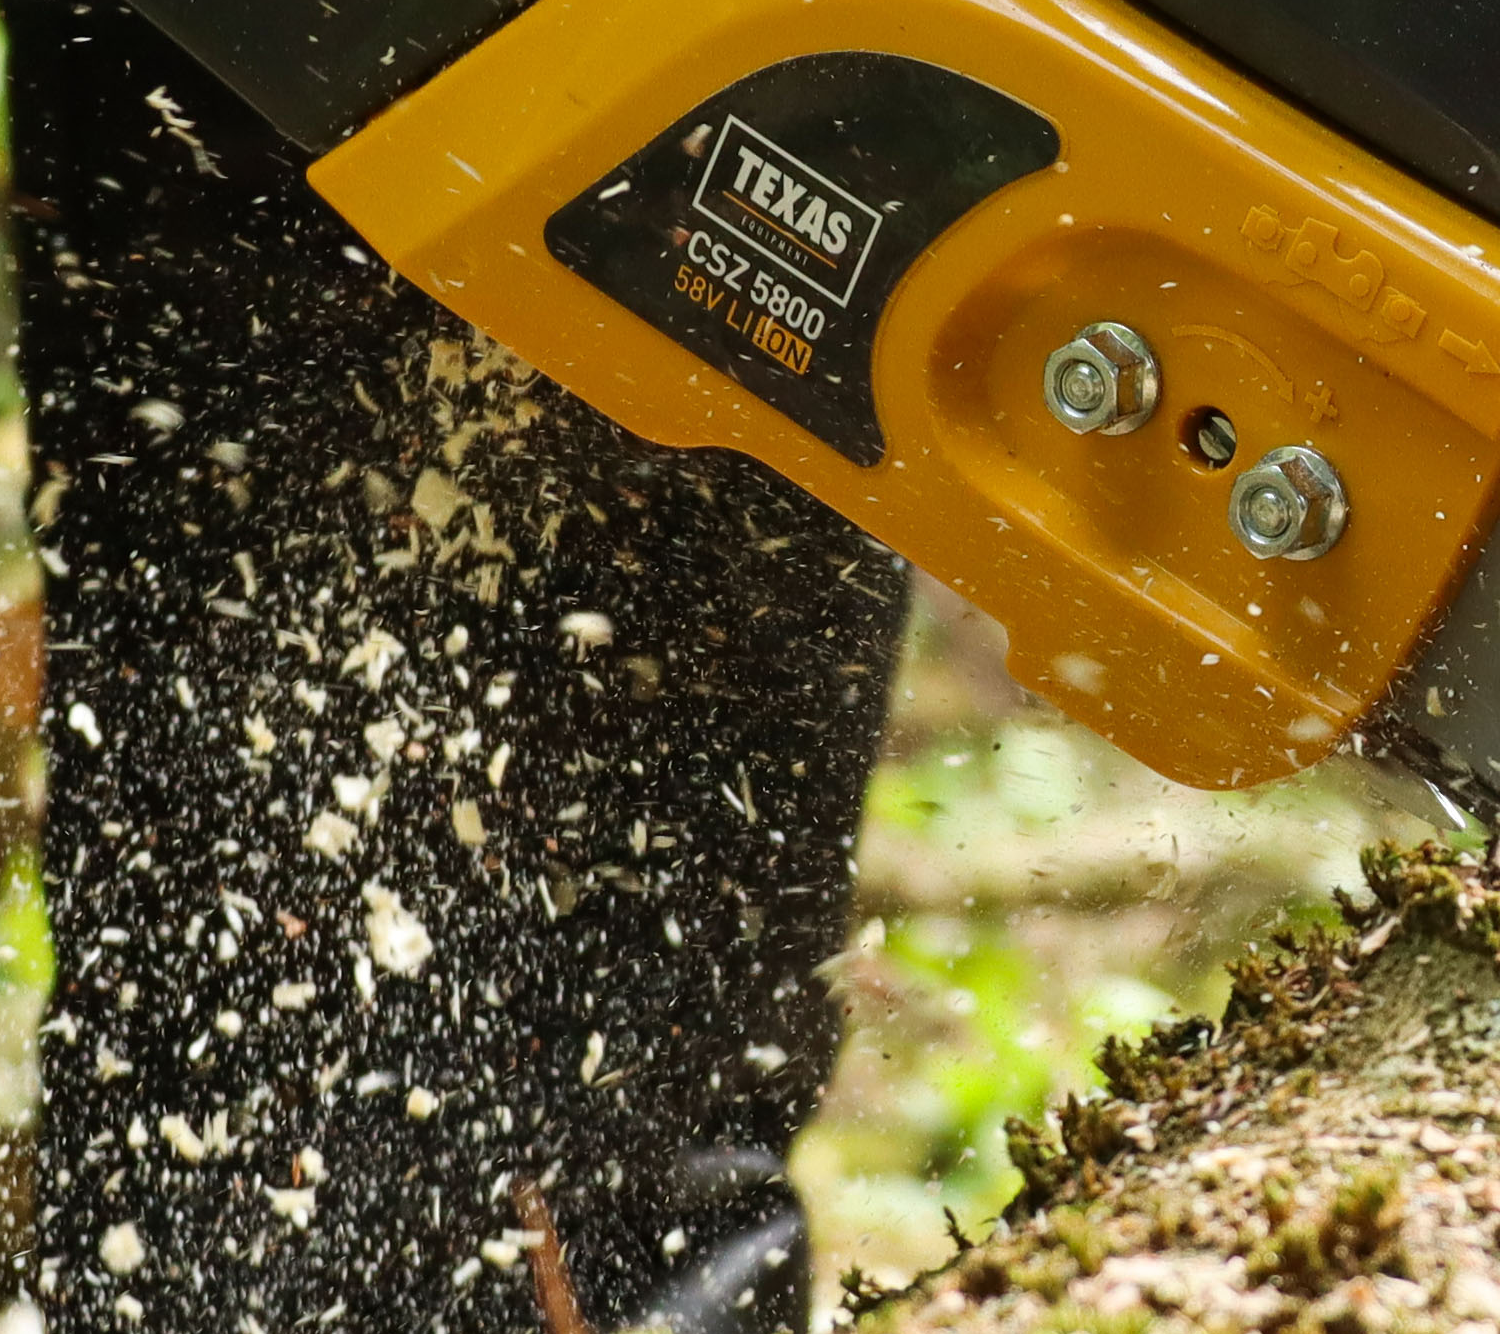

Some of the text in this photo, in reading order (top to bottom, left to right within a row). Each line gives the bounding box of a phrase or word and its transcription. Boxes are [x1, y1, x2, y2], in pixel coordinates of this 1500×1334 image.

[733, 145, 852, 255] TEXAS
[741, 216, 810, 267] EQUIPMENT
[674, 264, 725, 311] 58V
[687, 230, 825, 341] CSZ 5800
